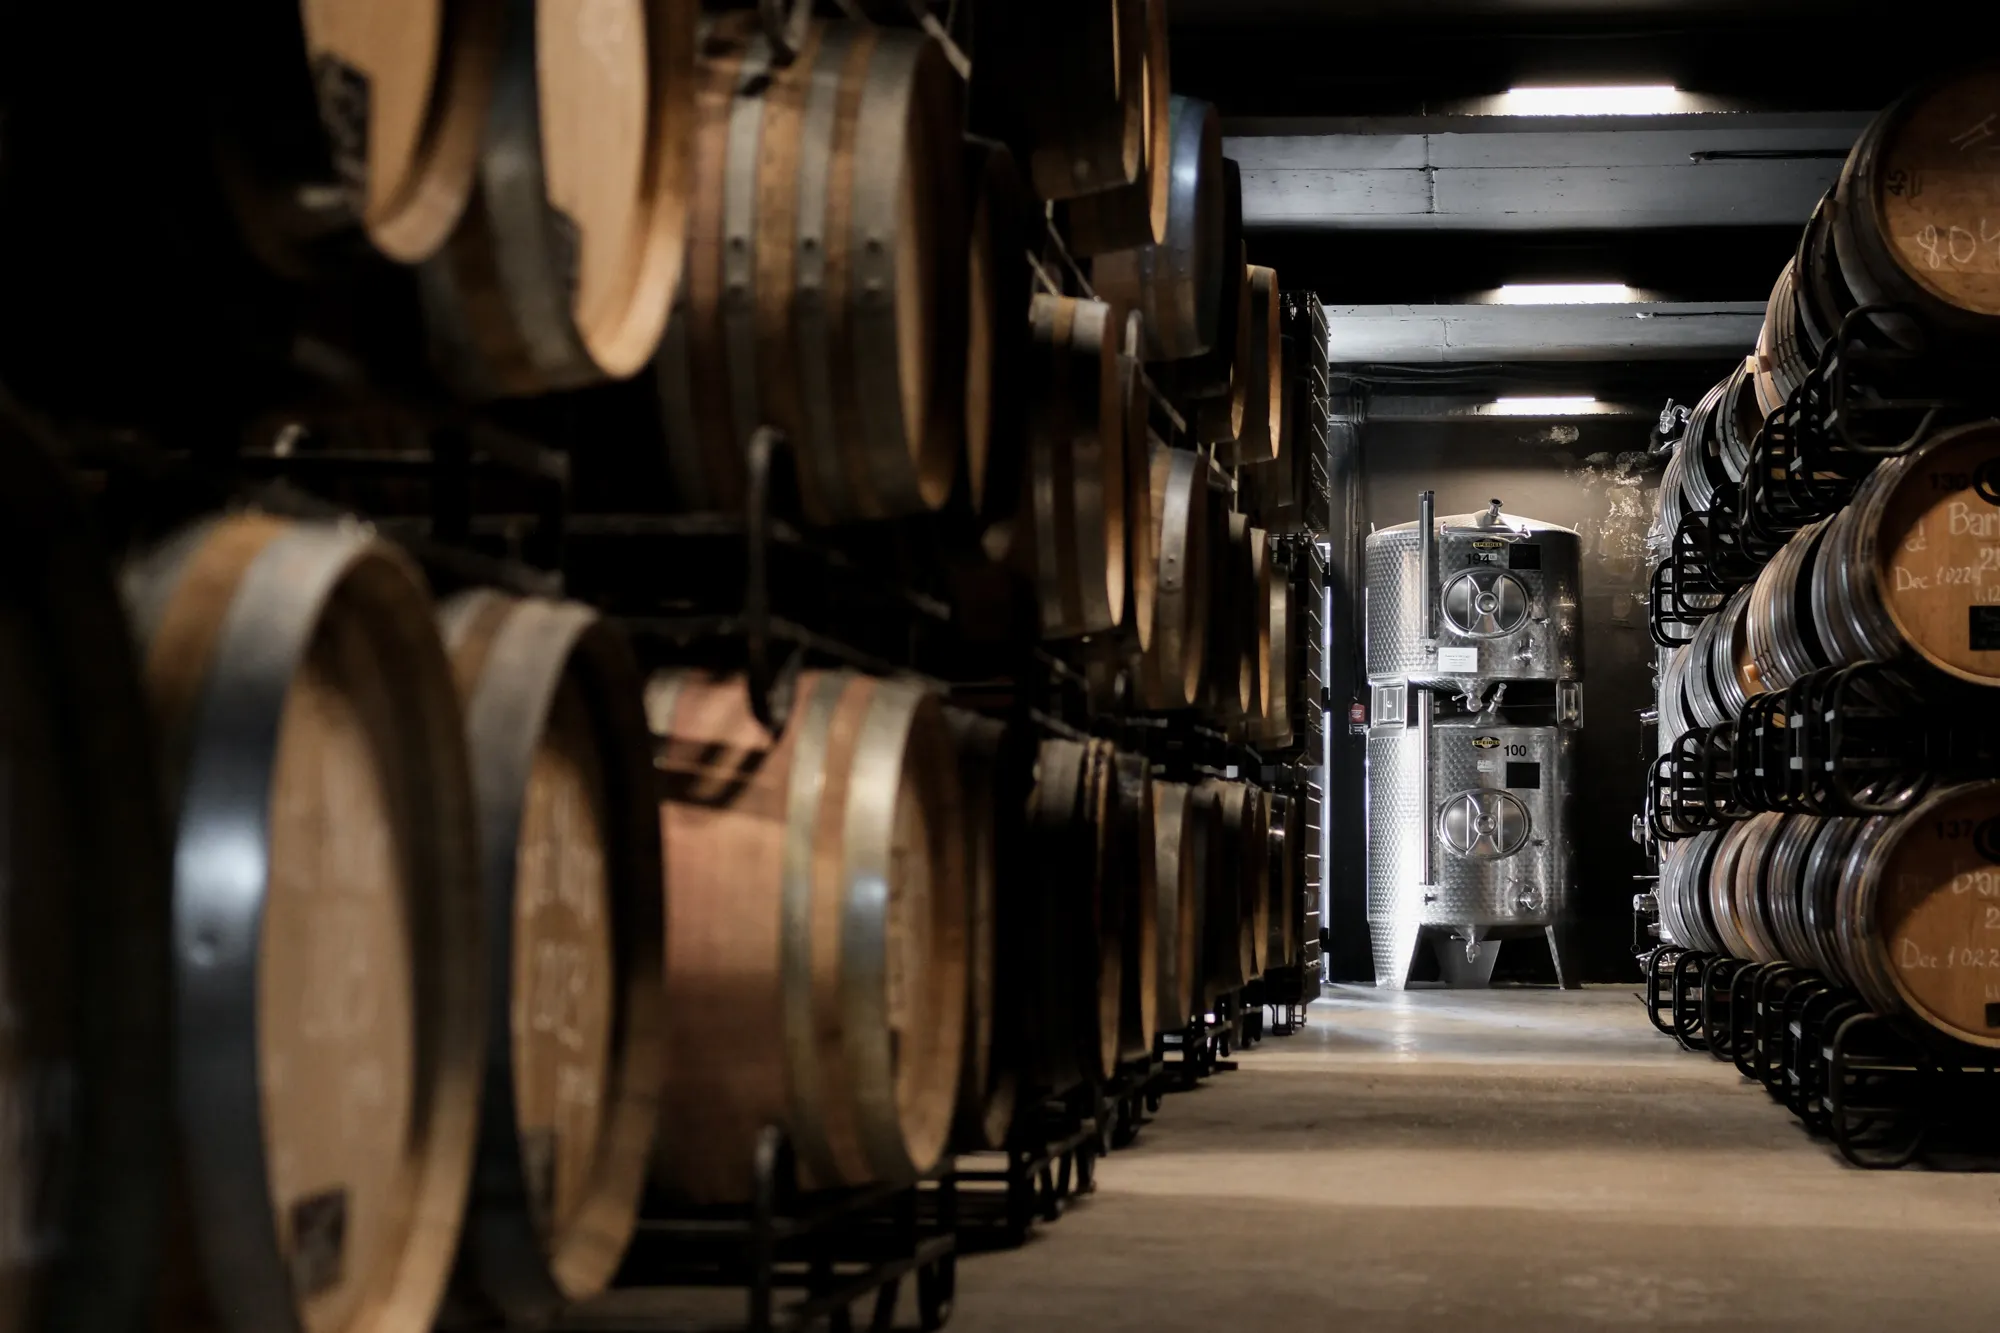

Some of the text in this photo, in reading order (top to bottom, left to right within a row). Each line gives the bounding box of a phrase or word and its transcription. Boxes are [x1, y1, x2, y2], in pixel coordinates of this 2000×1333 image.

[1948, 501, 2000, 536] Bar
[1465, 553, 1491, 565] 194
[1504, 744, 1527, 757] 100
[1935, 818, 1973, 840] 137
